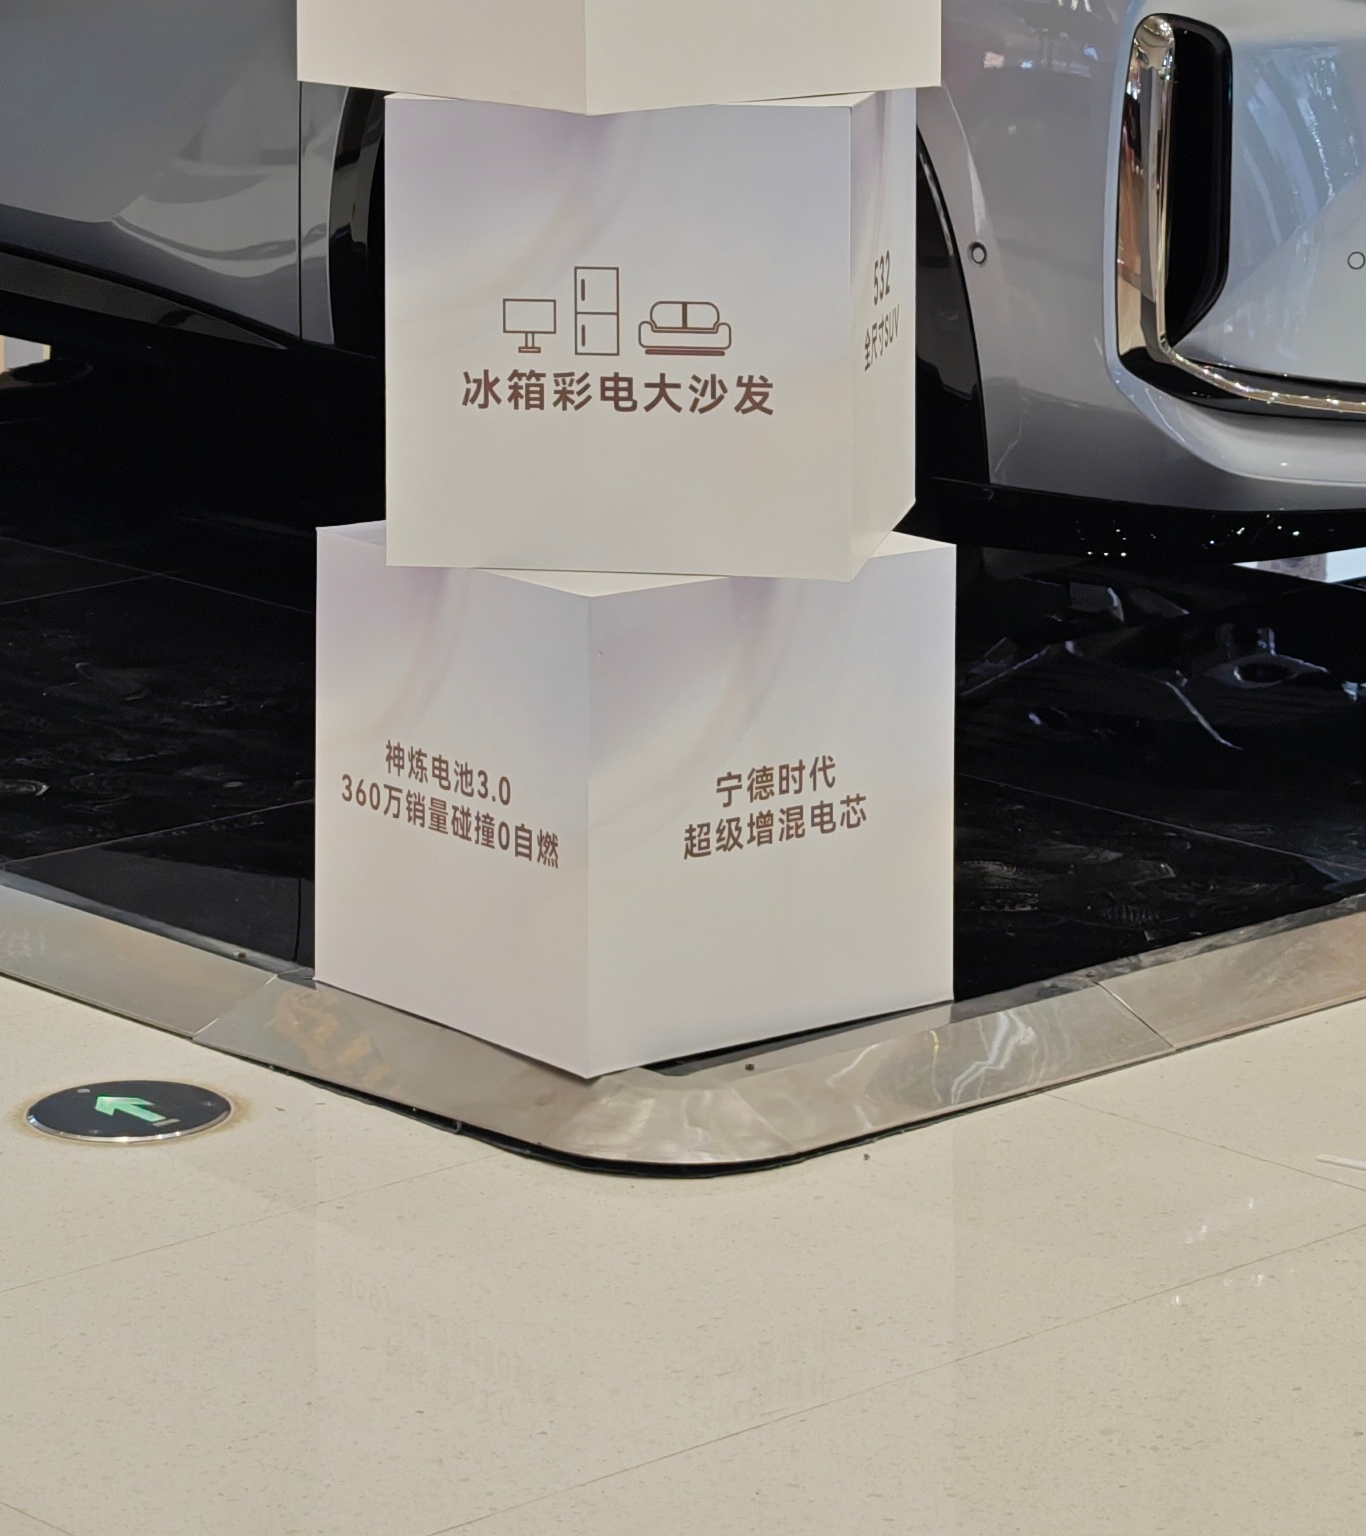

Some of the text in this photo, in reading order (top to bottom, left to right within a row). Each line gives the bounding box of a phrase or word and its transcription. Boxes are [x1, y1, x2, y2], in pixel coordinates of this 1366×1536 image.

[873, 250, 891, 306] 532
[864, 304, 900, 371] 全尺寸SUV
[461, 368, 775, 416] 冰箱彩电大沙发
[385, 739, 512, 806] 神炼电池3.0
[715, 754, 837, 808] 宁德时代
[341, 773, 559, 869] 360万销量碰撞0自燃
[682, 793, 868, 861] 超级增混电芯
